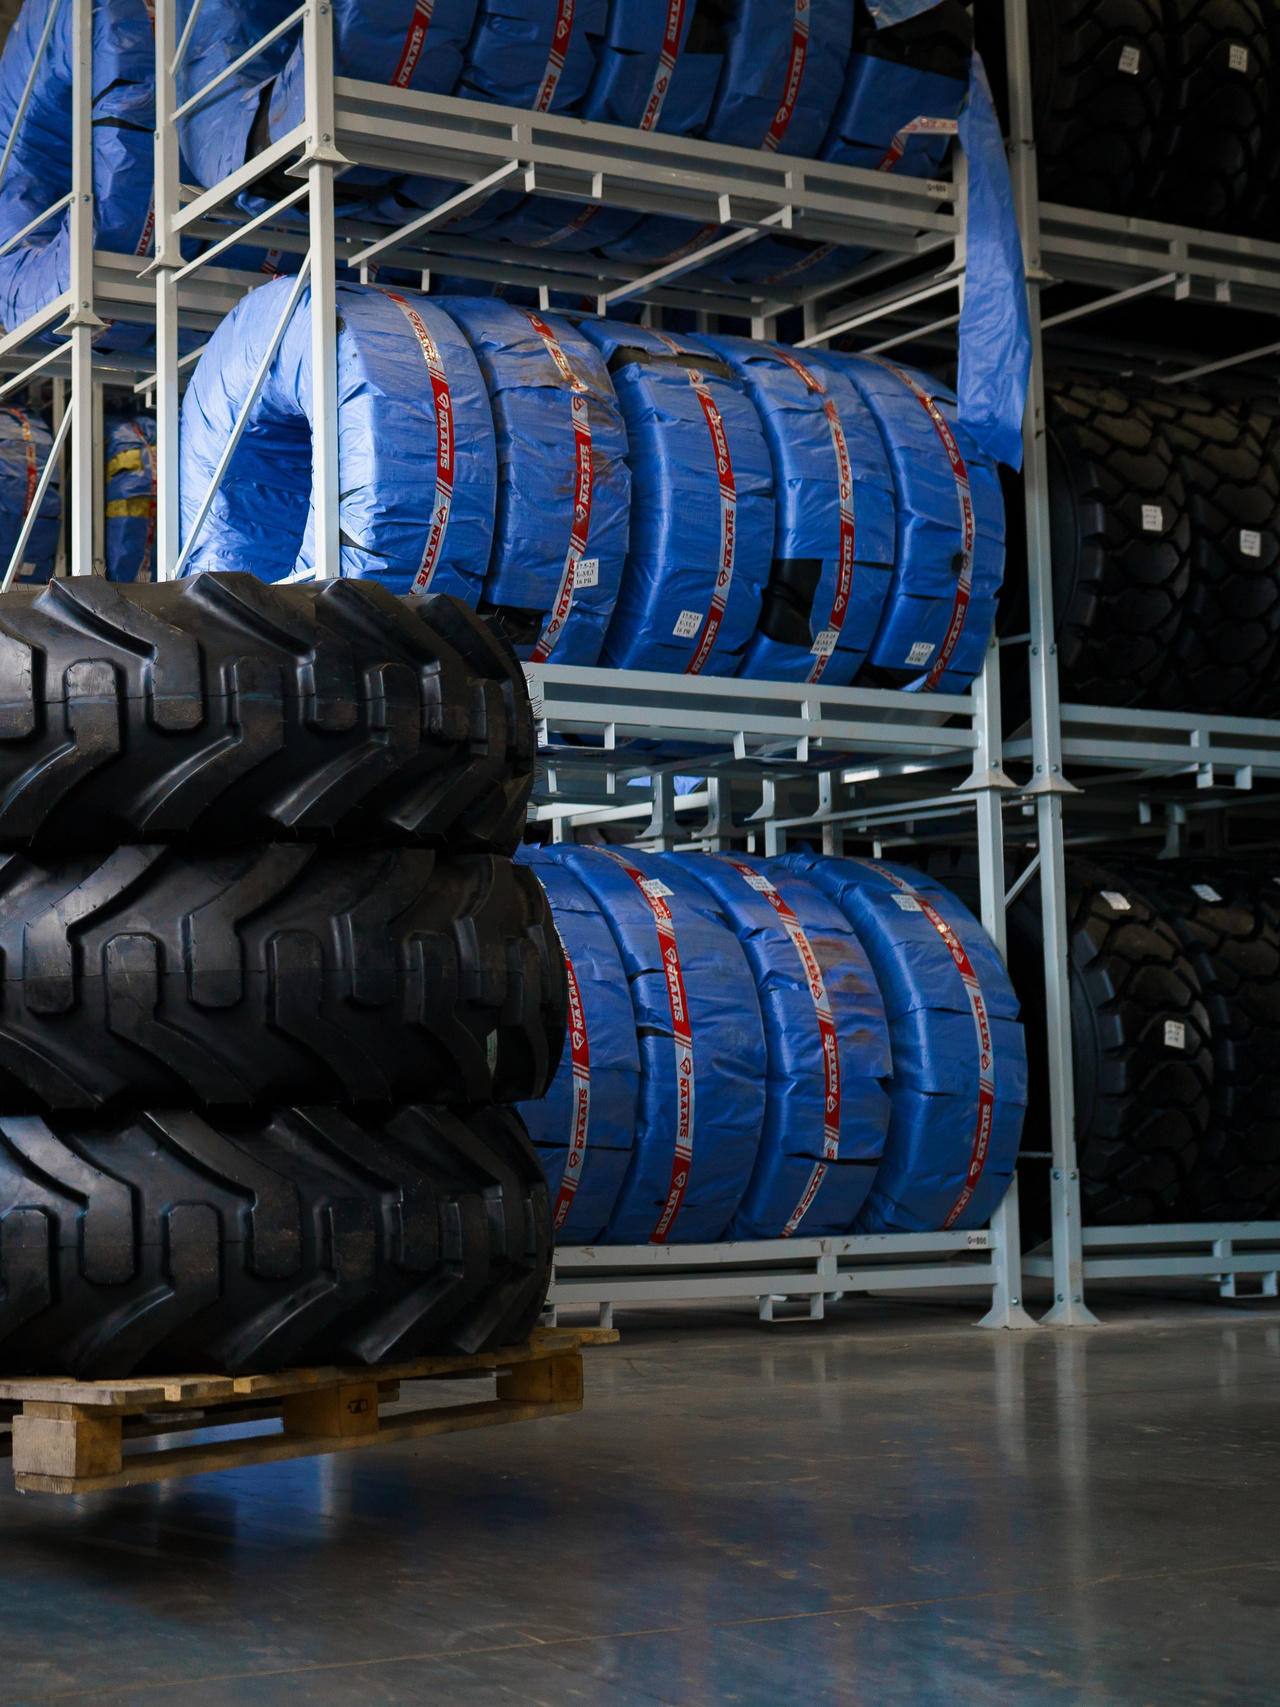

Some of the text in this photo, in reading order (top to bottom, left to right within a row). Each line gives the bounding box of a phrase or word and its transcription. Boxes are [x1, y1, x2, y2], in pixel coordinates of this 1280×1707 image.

[397, 25, 423, 86] NAAATS
[786, 47, 804, 107] NAAATS
[437, 408, 450, 470] NAAATS
[706, 404, 728, 458] NAAATS
[579, 443, 590, 505] NAAATS
[417, 524, 441, 588] NAAATS
[724, 508, 734, 568] NAAATS
[840, 534, 852, 594] NAAATS
[692, 619, 718, 673] NAAATS
[943, 604, 965, 658] NAAATS
[793, 930, 820, 983] NAAATS
[666, 963, 685, 1022] NAAATS
[973, 995, 991, 1052] NAAATS
[825, 1033, 838, 1094] NAAATS
[575, 1087, 588, 1150] NAAATS
[679, 1077, 690, 1138] NAAATS
[976, 1104, 991, 1160] NAAATS
[656, 1188, 680, 1236] NAAATS
